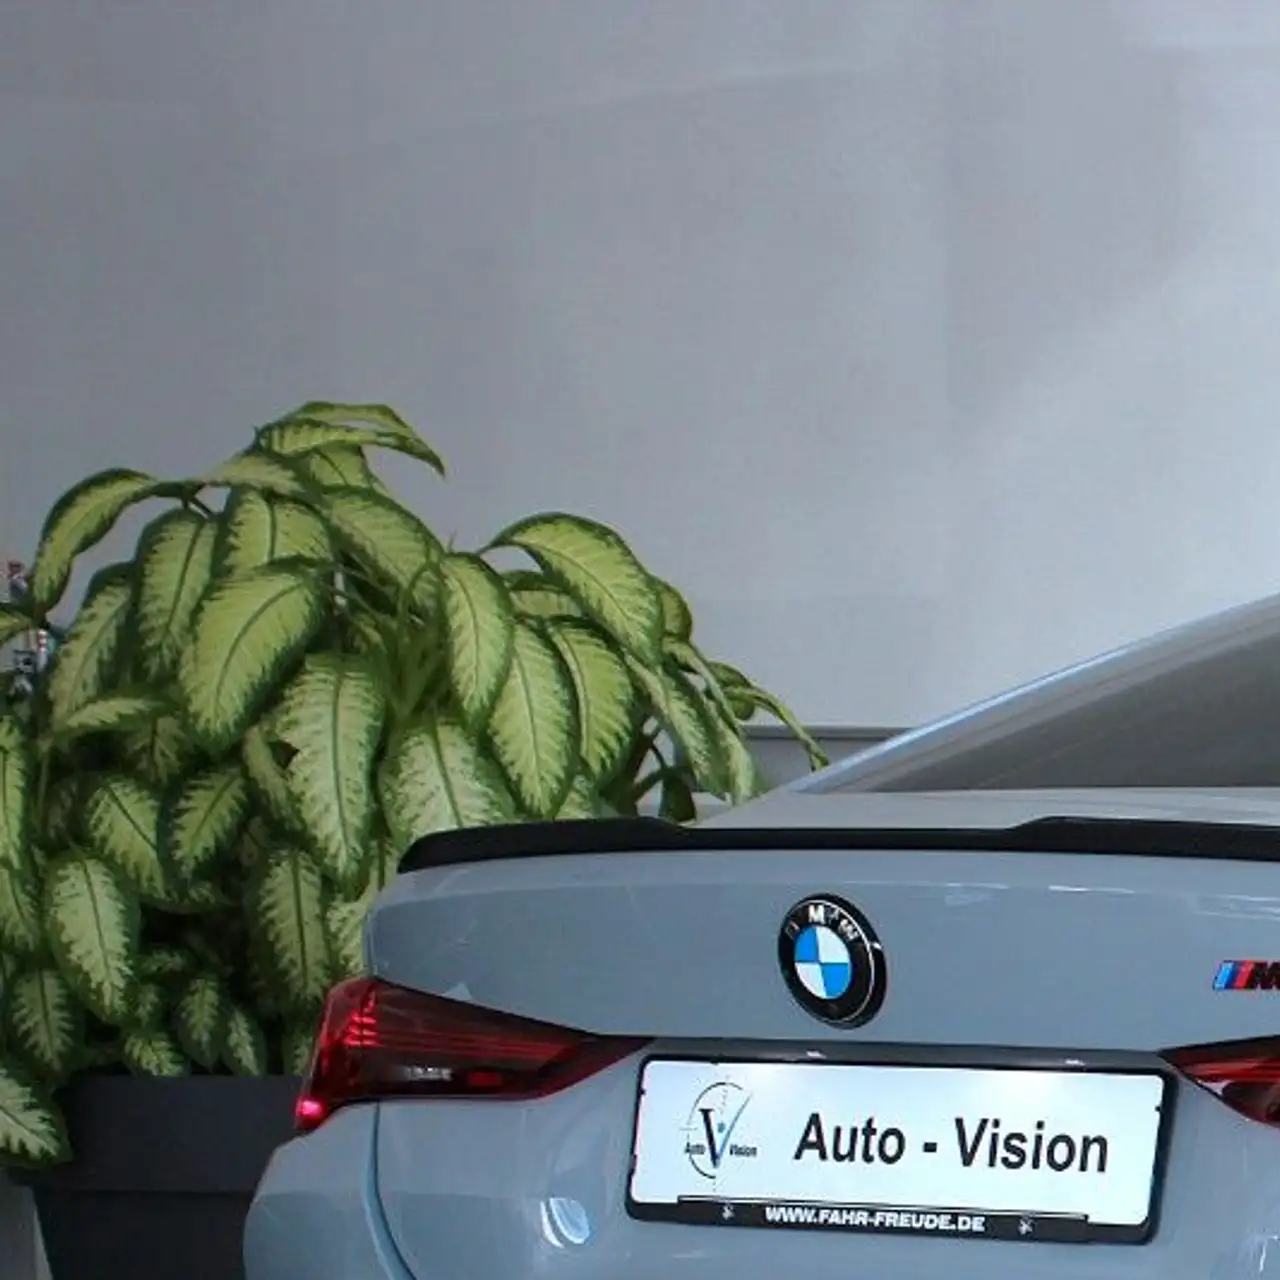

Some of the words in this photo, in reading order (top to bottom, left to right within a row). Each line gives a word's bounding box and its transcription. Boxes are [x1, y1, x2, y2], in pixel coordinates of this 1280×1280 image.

[793, 1112, 906, 1165] Auto
[922, 1141, 938, 1153] -
[954, 1116, 1109, 1173] Vision
[764, 1206, 986, 1232] WWW.FAHR-FREUDE.DE
